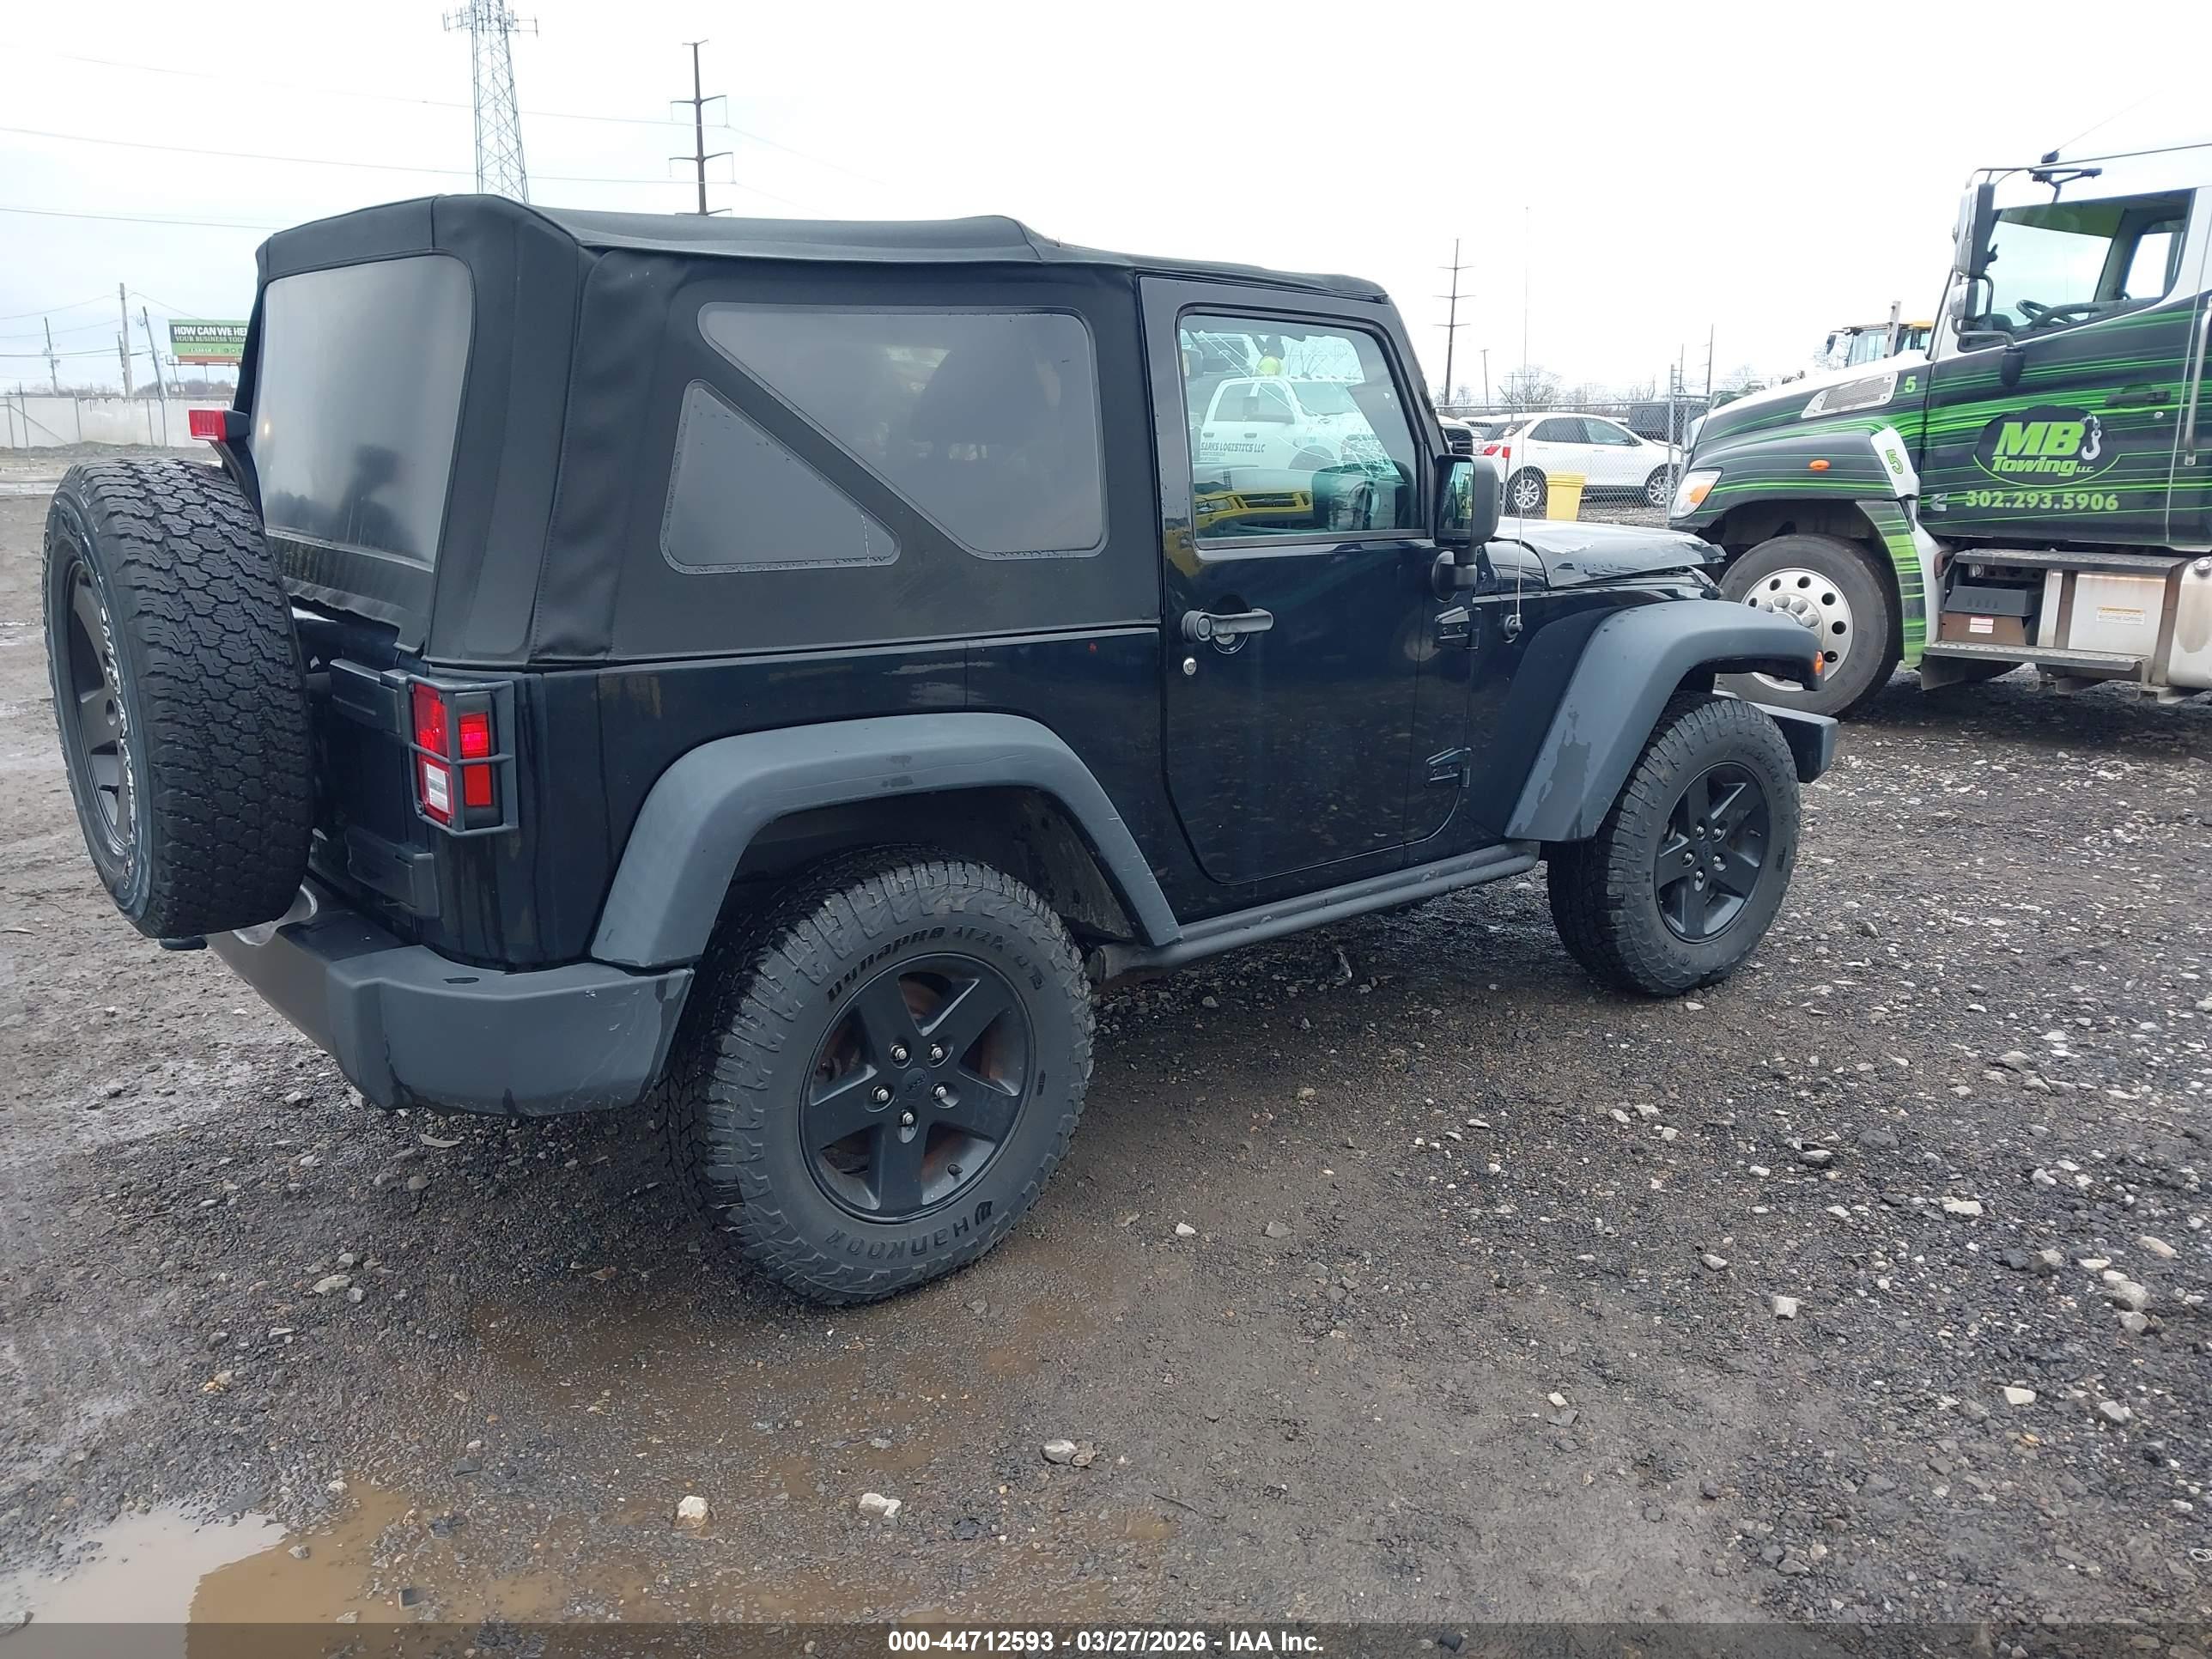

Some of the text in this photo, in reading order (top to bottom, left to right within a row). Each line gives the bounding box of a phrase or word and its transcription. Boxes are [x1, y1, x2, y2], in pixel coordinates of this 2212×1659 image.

[173, 326, 197, 336] HOW
[197, 326, 216, 336] CAN
[217, 326, 233, 337] WE
[1904, 375, 1917, 393] 5
[1219, 442, 1254, 453] LOGISTICS
[1254, 443, 1266, 453] LLC
[1992, 422, 2086, 457] MB
[1885, 448, 1904, 475] 5
[1991, 456, 2079, 477] Towing
[1965, 490, 2119, 511] 302.293.5906
